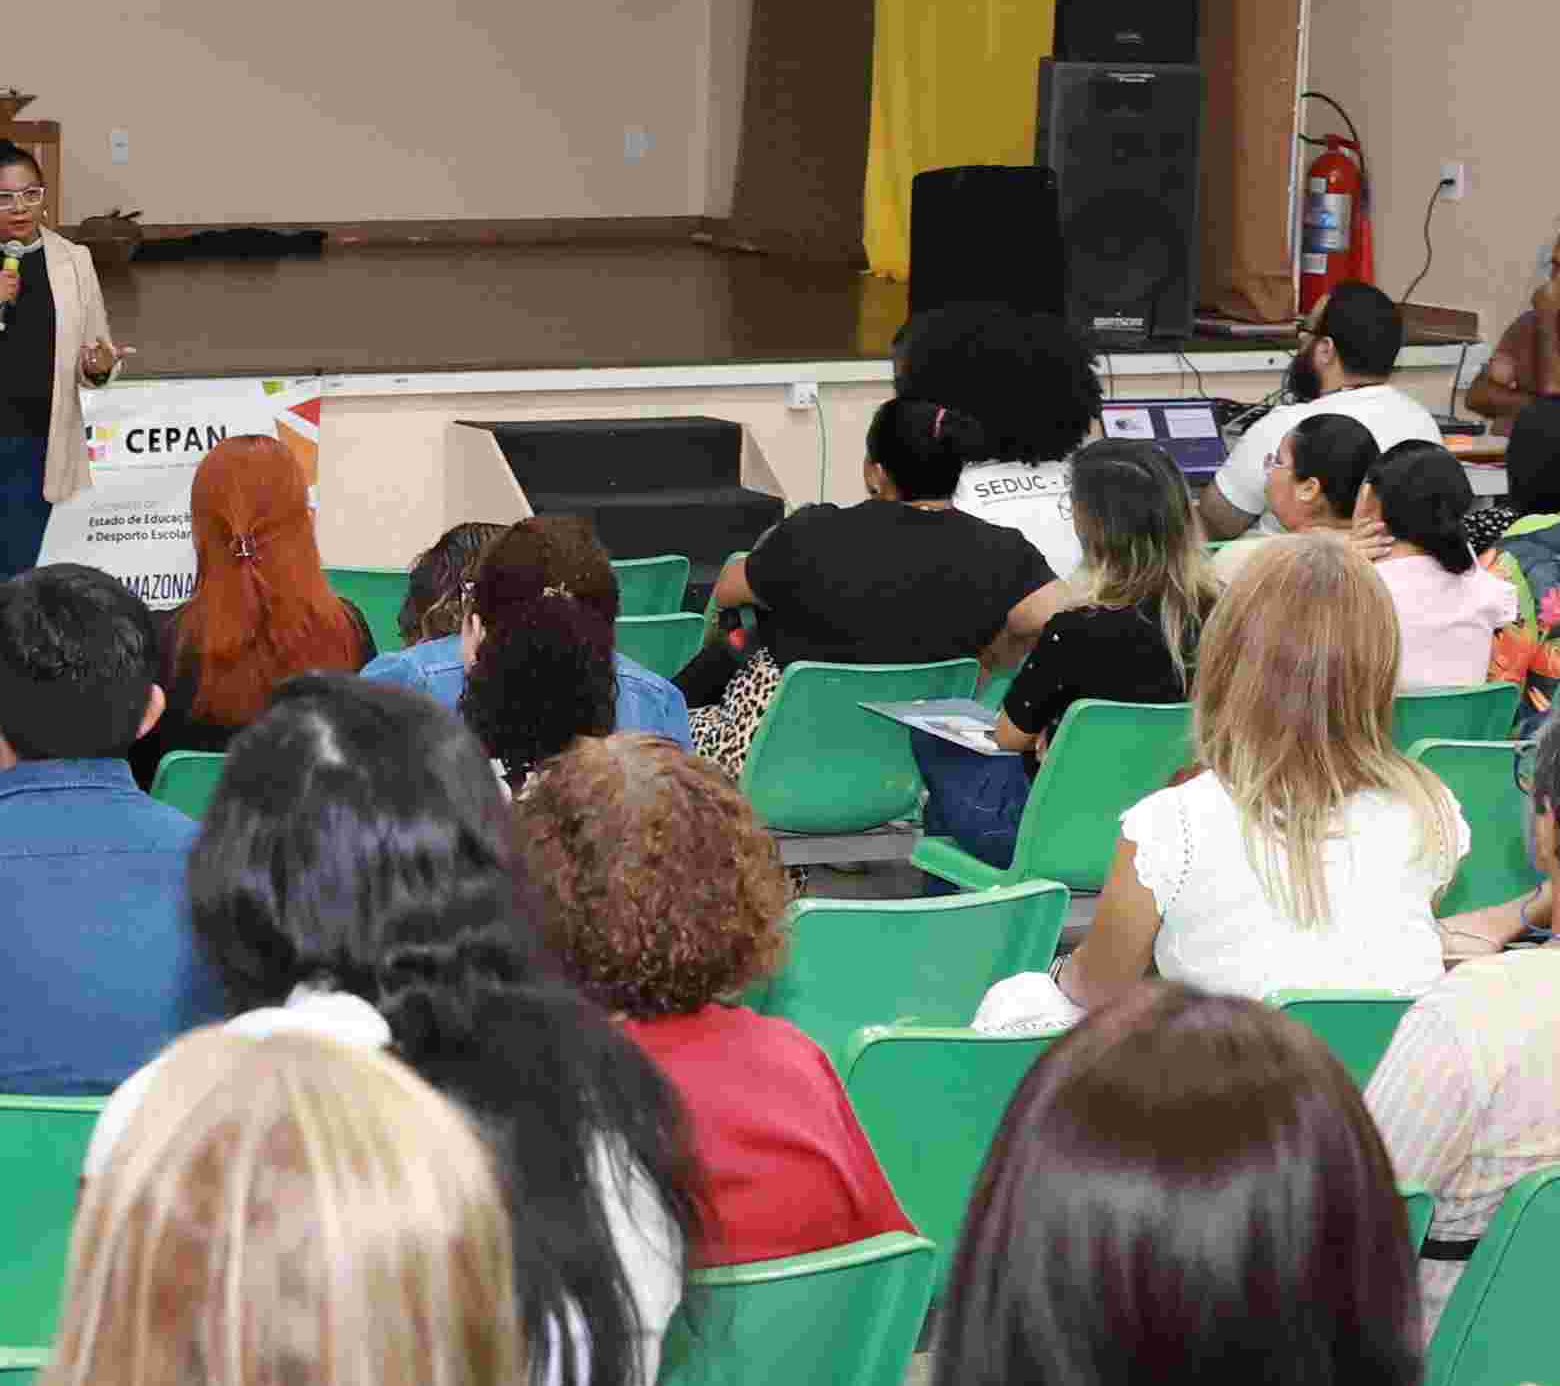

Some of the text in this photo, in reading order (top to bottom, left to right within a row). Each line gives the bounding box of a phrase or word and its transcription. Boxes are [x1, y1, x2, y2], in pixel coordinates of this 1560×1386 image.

[125, 424, 228, 453] CEPAN
[974, 475, 1047, 498] SEDUC
[88, 512, 193, 527] Estado de Educaçã
[96, 530, 149, 544] Desporto
